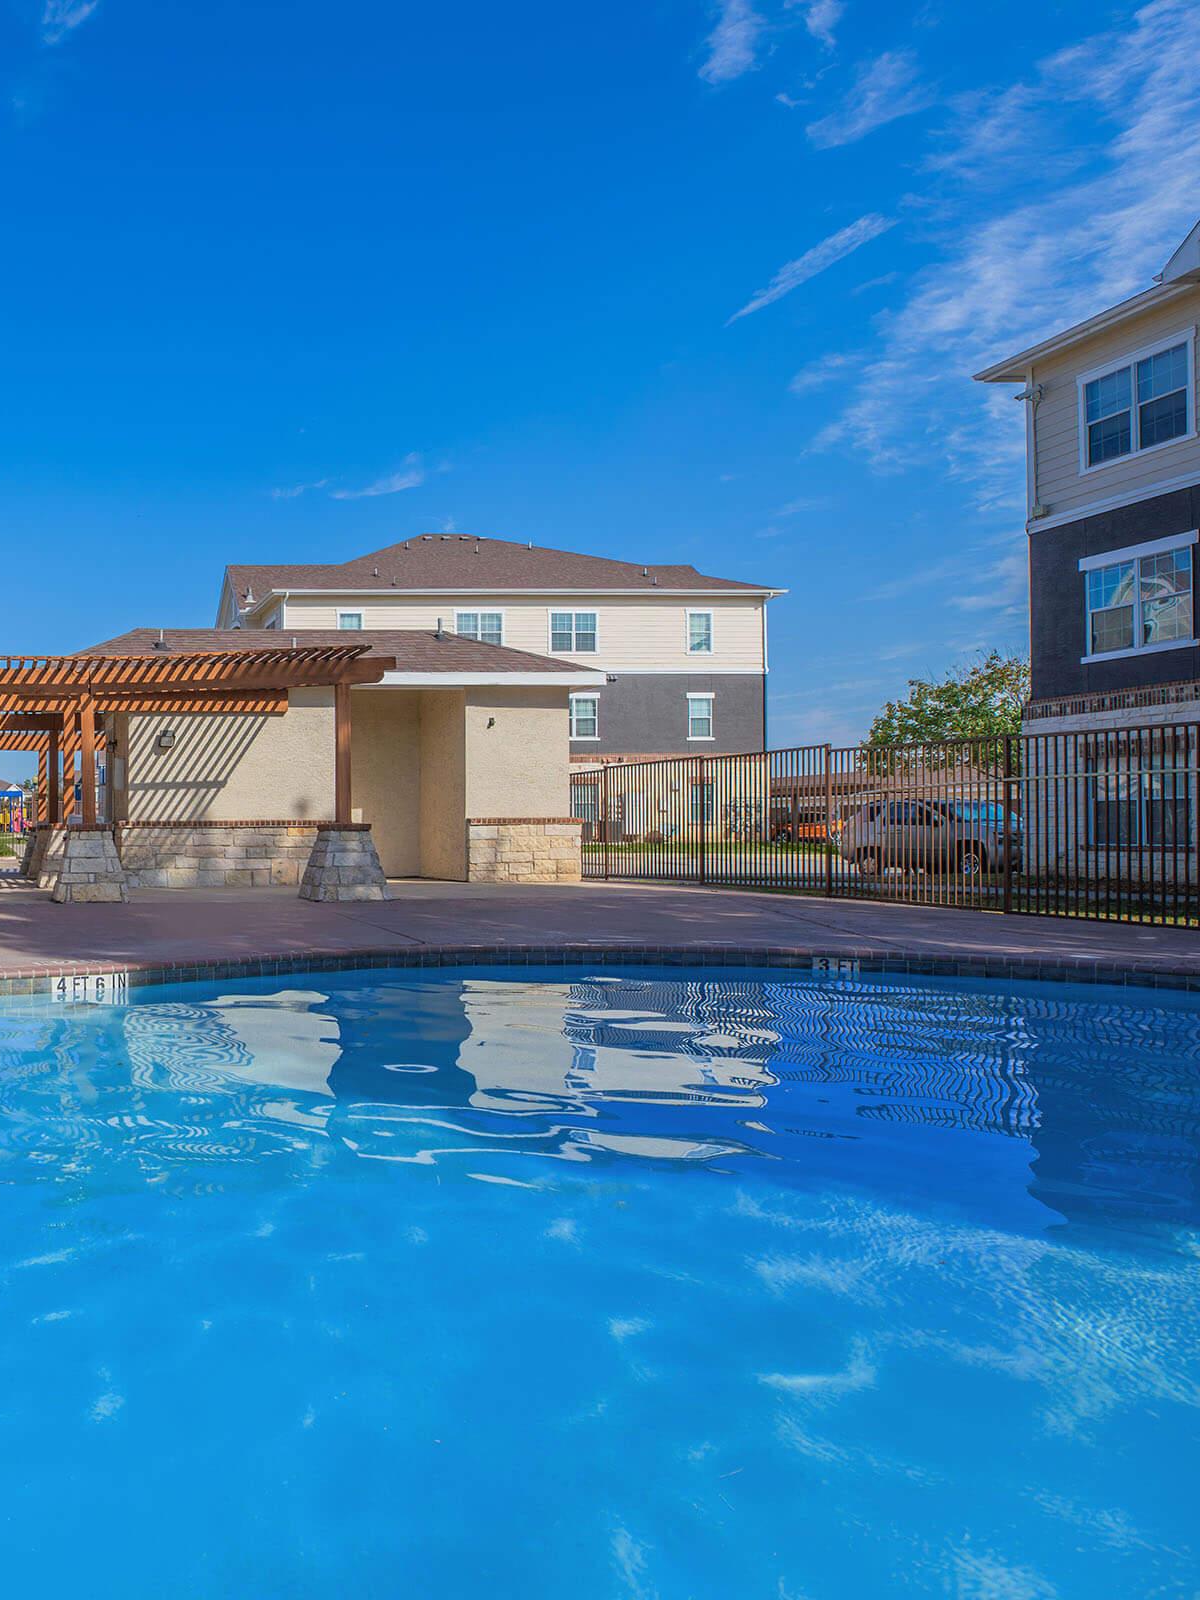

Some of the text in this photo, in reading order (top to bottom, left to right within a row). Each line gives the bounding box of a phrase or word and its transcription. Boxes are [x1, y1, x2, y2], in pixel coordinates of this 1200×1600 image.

[818, 958, 858, 971] 3 FT
[56, 973, 126, 992] 4 FT 6 IN
